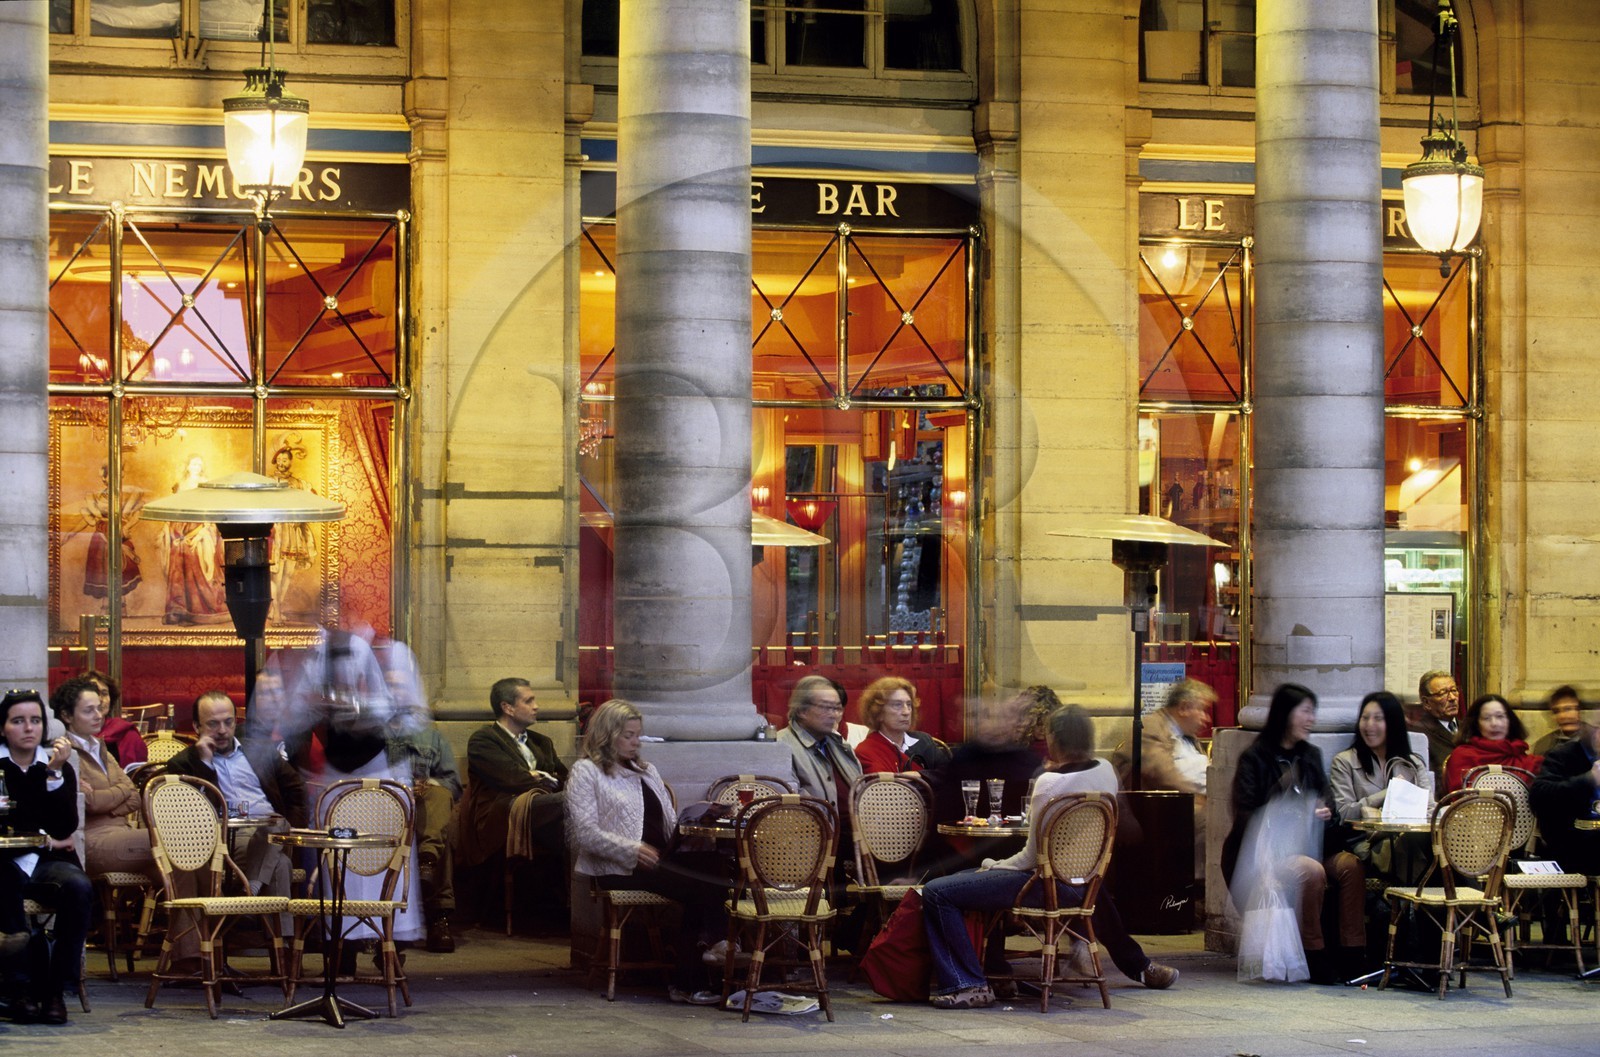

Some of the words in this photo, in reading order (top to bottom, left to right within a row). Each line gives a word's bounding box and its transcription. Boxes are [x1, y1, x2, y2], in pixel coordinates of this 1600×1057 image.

[131, 162, 341, 202] NEMRS
[817, 183, 900, 218] BAR
[1177, 198, 1226, 232] LE
